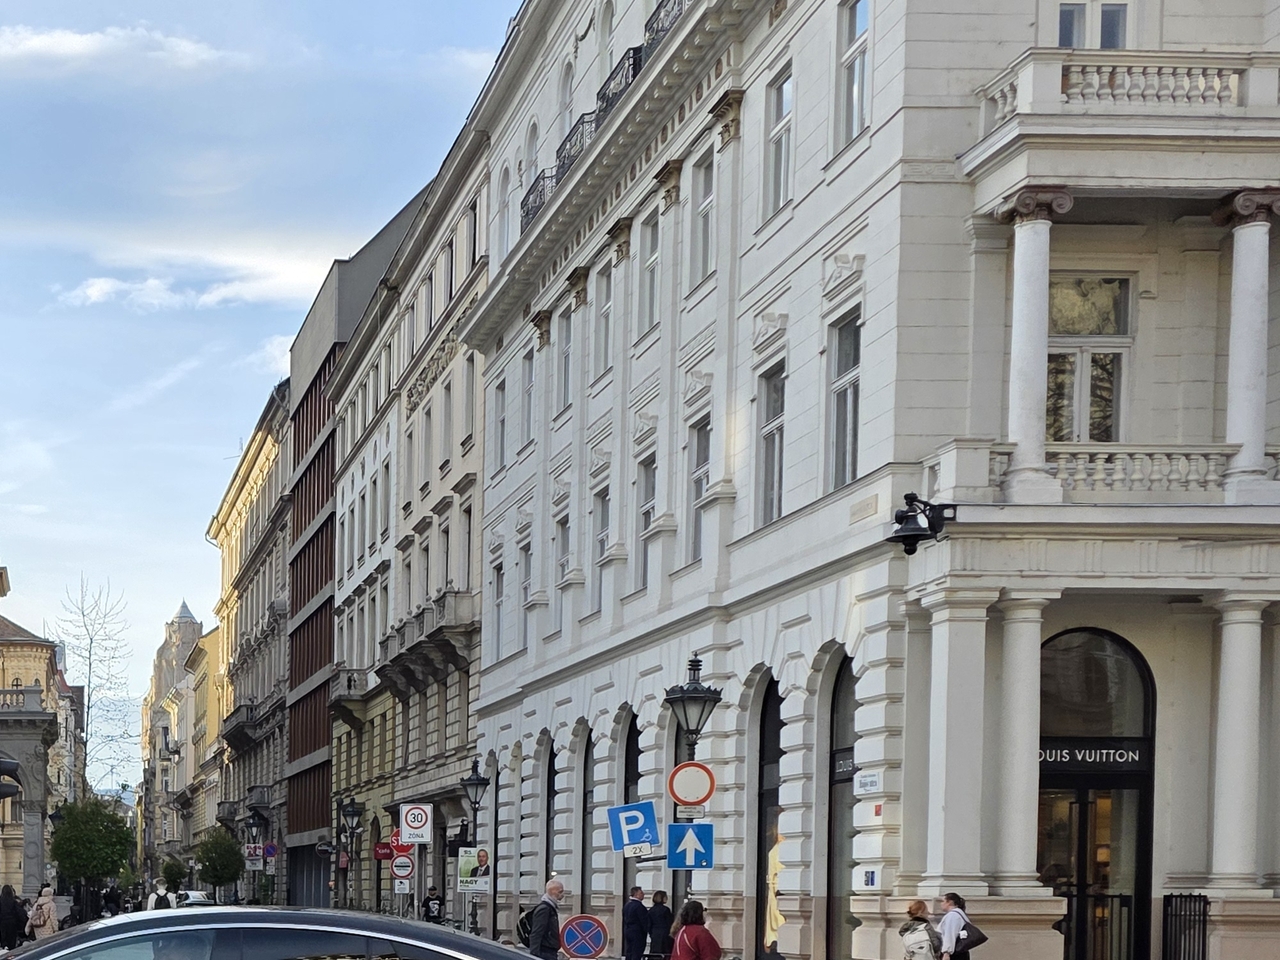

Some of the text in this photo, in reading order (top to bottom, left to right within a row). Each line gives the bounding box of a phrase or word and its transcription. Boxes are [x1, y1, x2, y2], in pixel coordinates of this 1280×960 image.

[1075, 749, 1139, 762] VUITTON
[410, 812, 423, 823] 30
[619, 810, 645, 845] P
[631, 846, 644, 855] 2X
